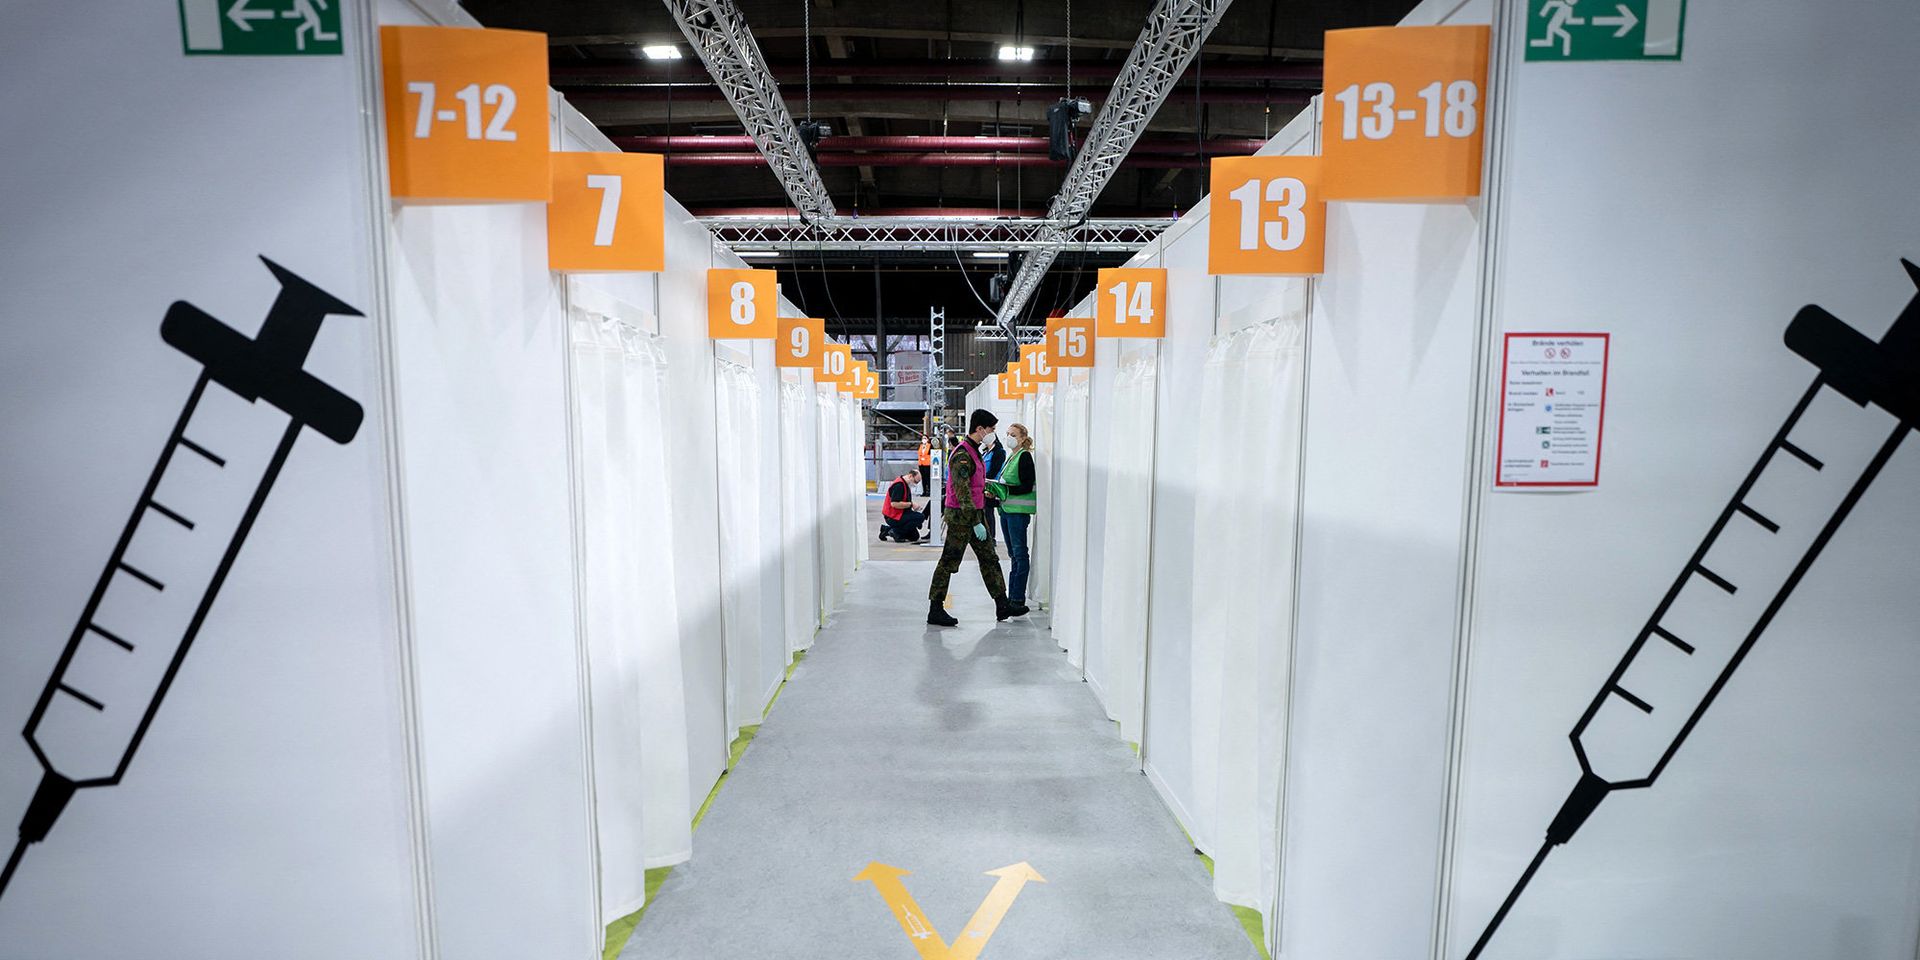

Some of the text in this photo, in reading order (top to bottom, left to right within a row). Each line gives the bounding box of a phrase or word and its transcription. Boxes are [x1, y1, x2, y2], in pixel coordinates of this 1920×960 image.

[409, 82, 517, 141] 7-12
[1335, 80, 1478, 140] 13-18
[587, 174, 622, 246] 7
[1229, 177, 1307, 251] 13
[730, 281, 755, 325] 8
[1109, 281, 1154, 324] 14
[791, 326, 810, 358] 9
[823, 351, 845, 375] 10
[1053, 326, 1087, 358] 15
